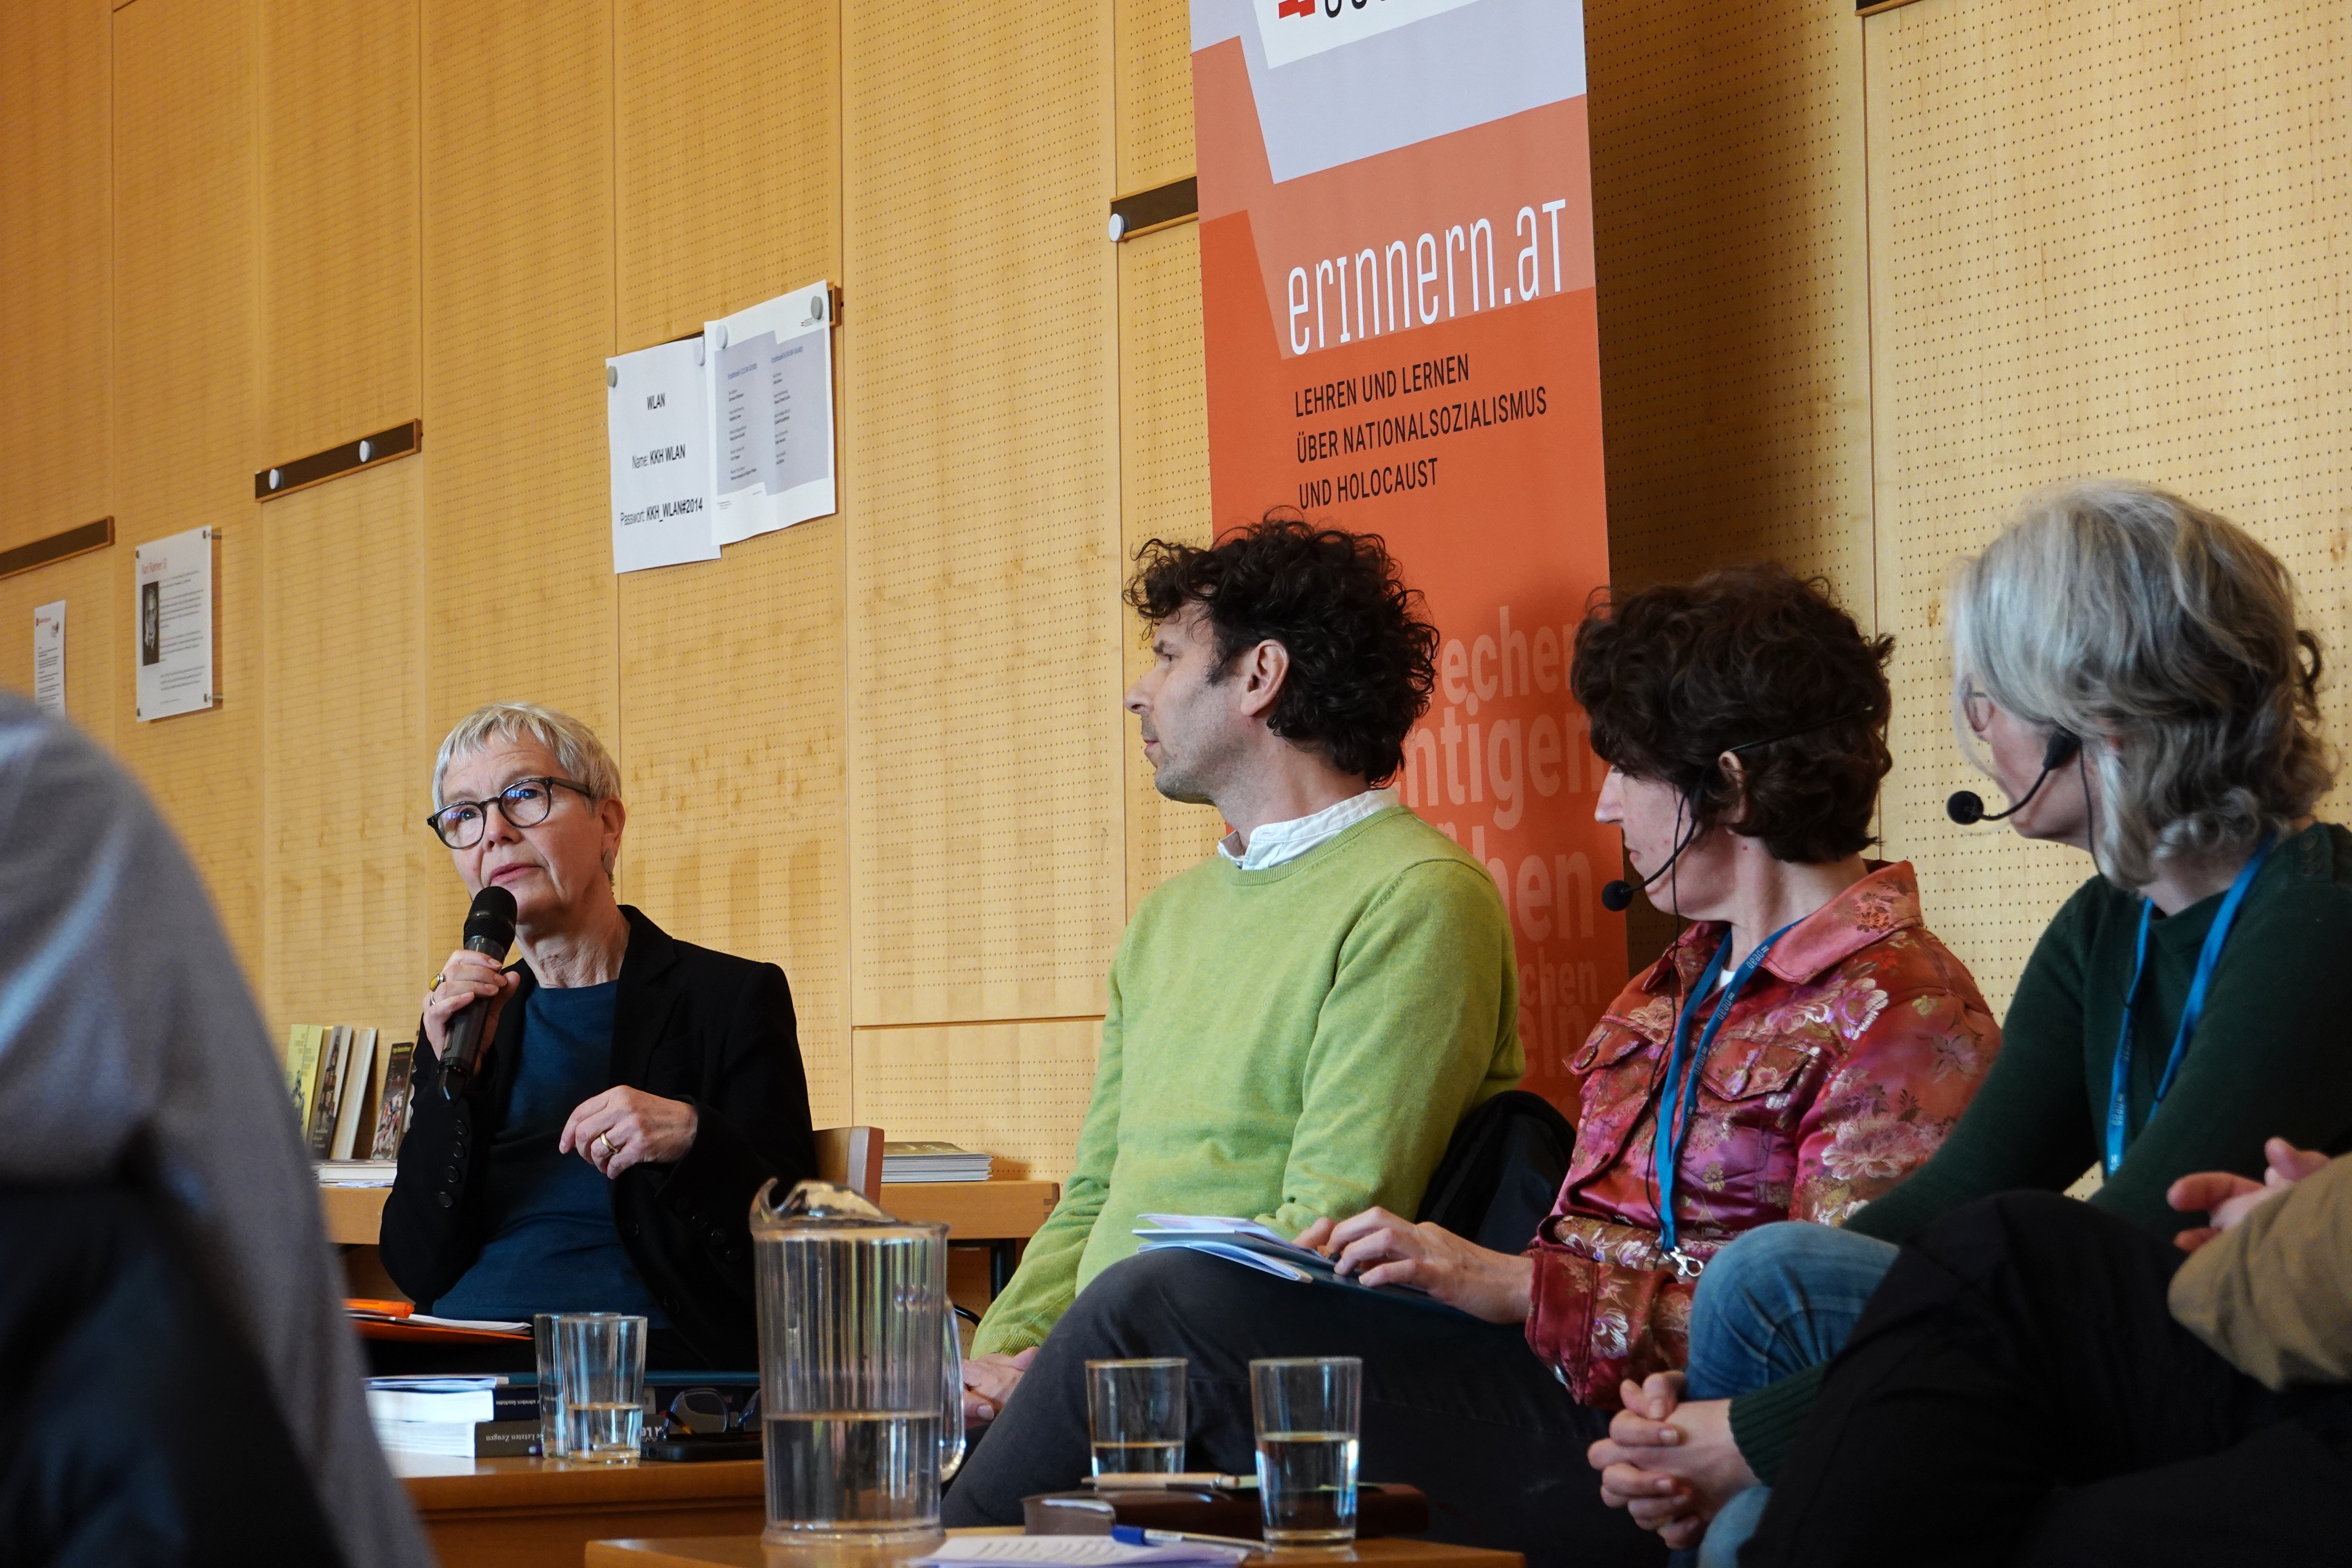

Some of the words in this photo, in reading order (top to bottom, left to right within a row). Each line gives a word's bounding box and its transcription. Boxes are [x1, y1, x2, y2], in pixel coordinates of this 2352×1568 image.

[647, 393, 666, 410] WLAN
[1295, 378, 1357, 417] LEHREN
[1362, 370, 1397, 403] UND
[1402, 353, 1469, 394] LERNEN
[1297, 430, 1338, 463] ÜBER
[1343, 386, 1547, 455] NATIONALSOZIALISMUS
[632, 455, 649, 469] Name:
[650, 448, 664, 465] KKH
[665, 443, 686, 462] WLAN
[1299, 479, 1332, 509] UND
[1337, 457, 1438, 503] HOLOCAUST
[646, 497, 703, 523] KKH_WLAN#2014
[1519, 945, 1599, 1008] chen
[486, 1433, 509, 1442] Zeugen
